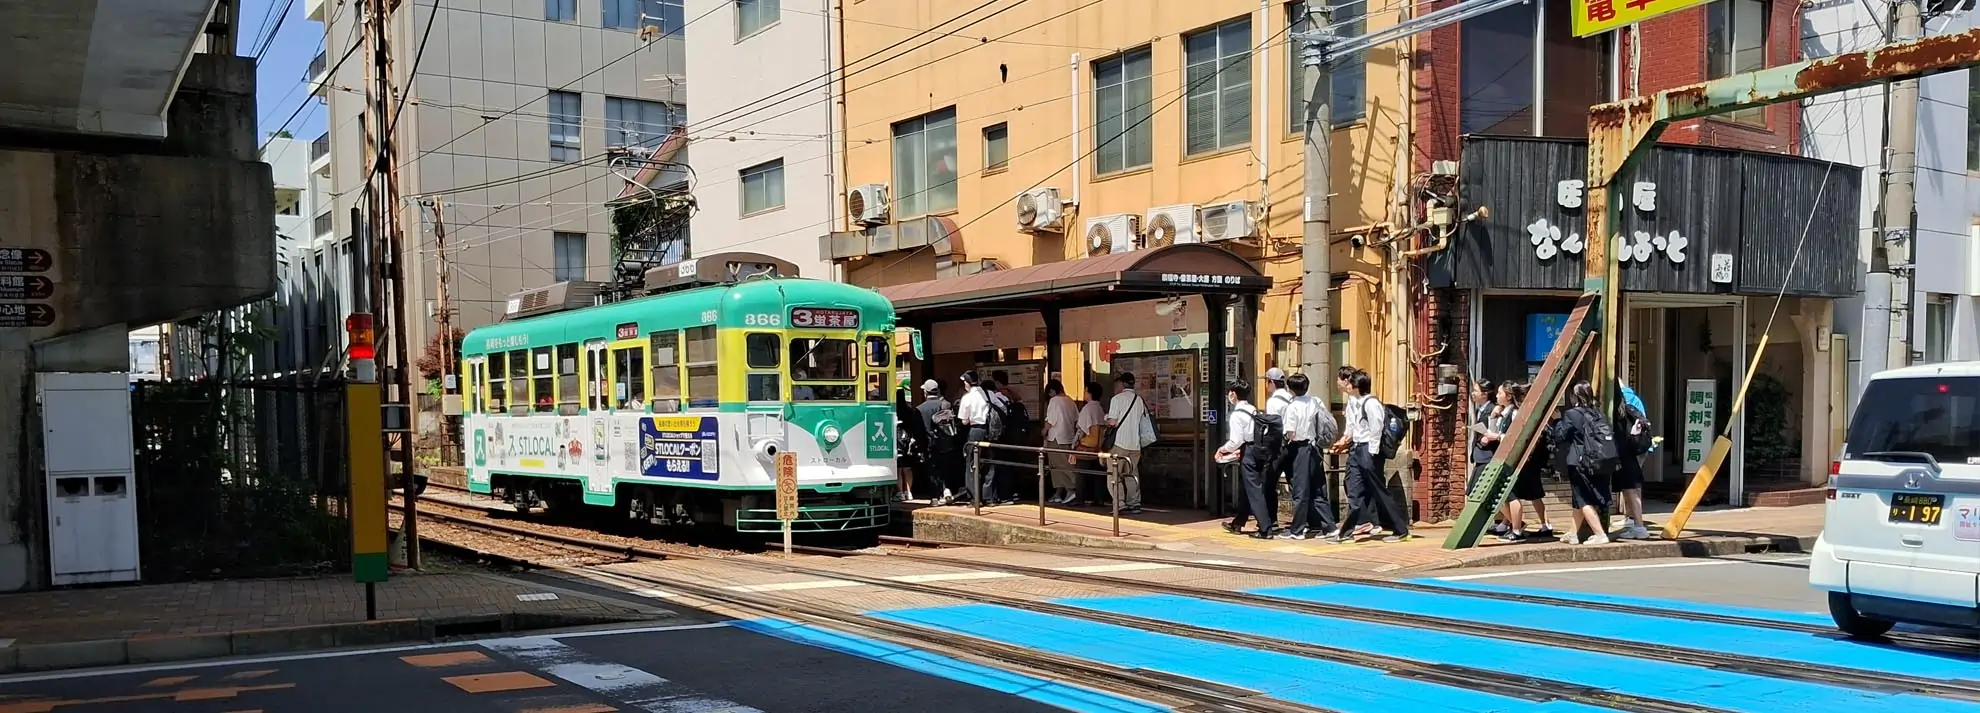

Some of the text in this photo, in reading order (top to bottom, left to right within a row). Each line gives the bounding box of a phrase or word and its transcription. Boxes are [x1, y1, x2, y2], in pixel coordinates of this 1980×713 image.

[0, 304, 26, 315] 心地
[793, 309, 813, 326] 3
[745, 313, 781, 326] 366
[1686, 390, 1704, 463] 調剤薬局
[519, 436, 556, 457] STLOCAL
[782, 455, 794, 477] 危険
